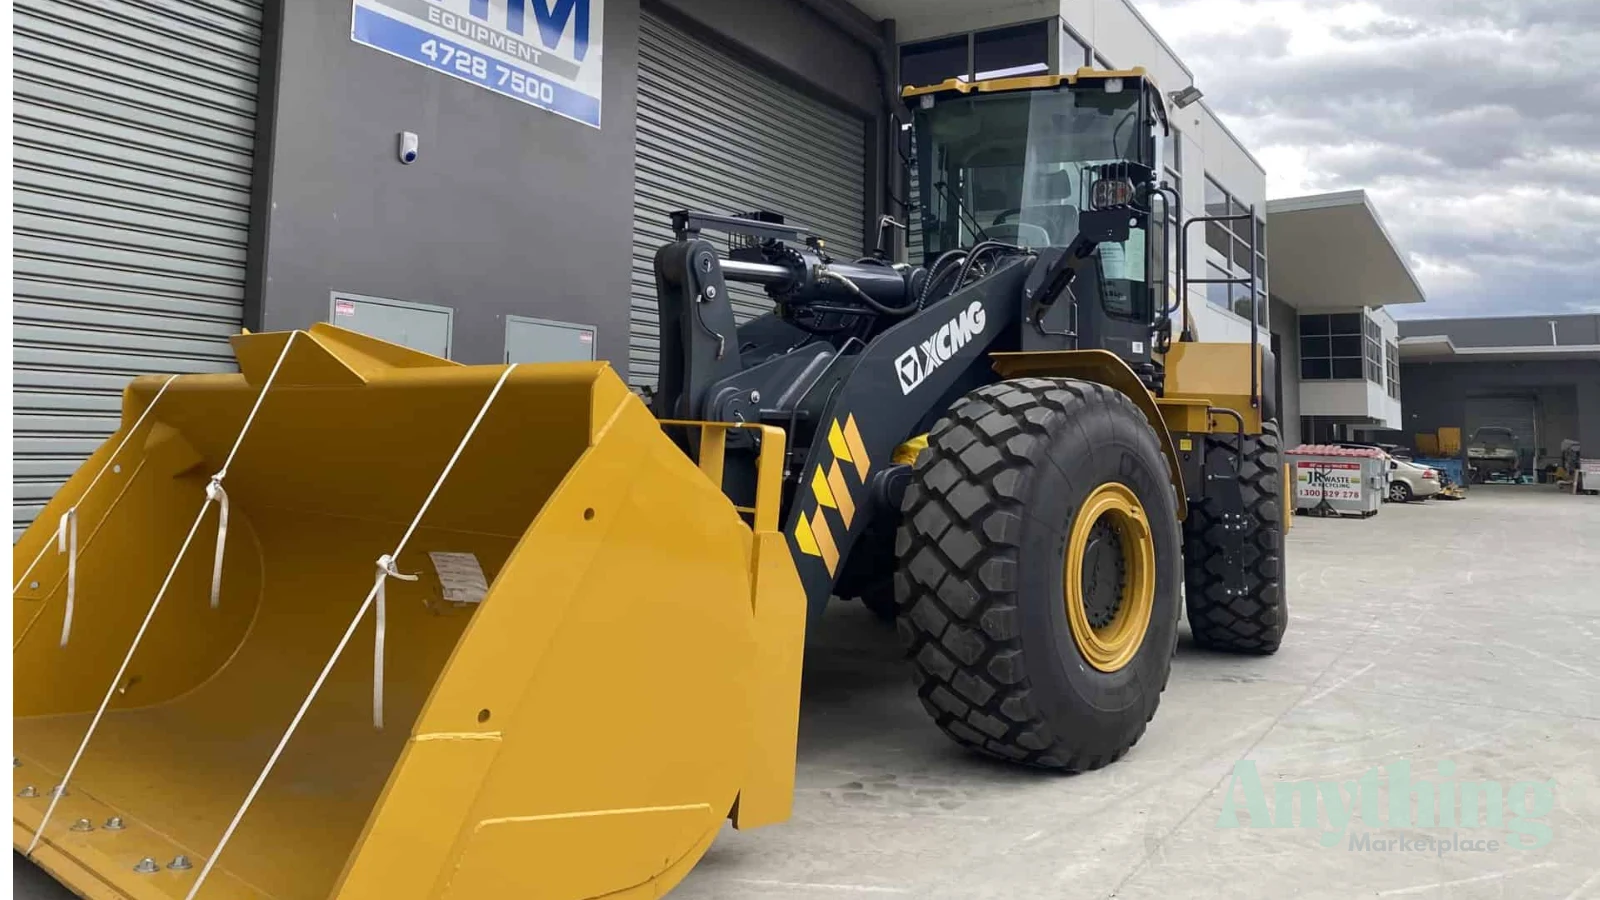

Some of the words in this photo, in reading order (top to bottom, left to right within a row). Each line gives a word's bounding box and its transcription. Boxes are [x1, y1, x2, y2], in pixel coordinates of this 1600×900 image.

[428, 6, 542, 64] EQUIPMENT
[421, 39, 487, 79] 4728
[495, 65, 554, 104] 7500
[919, 300, 986, 379] XCMG
[1342, 491, 1360, 499] 278
